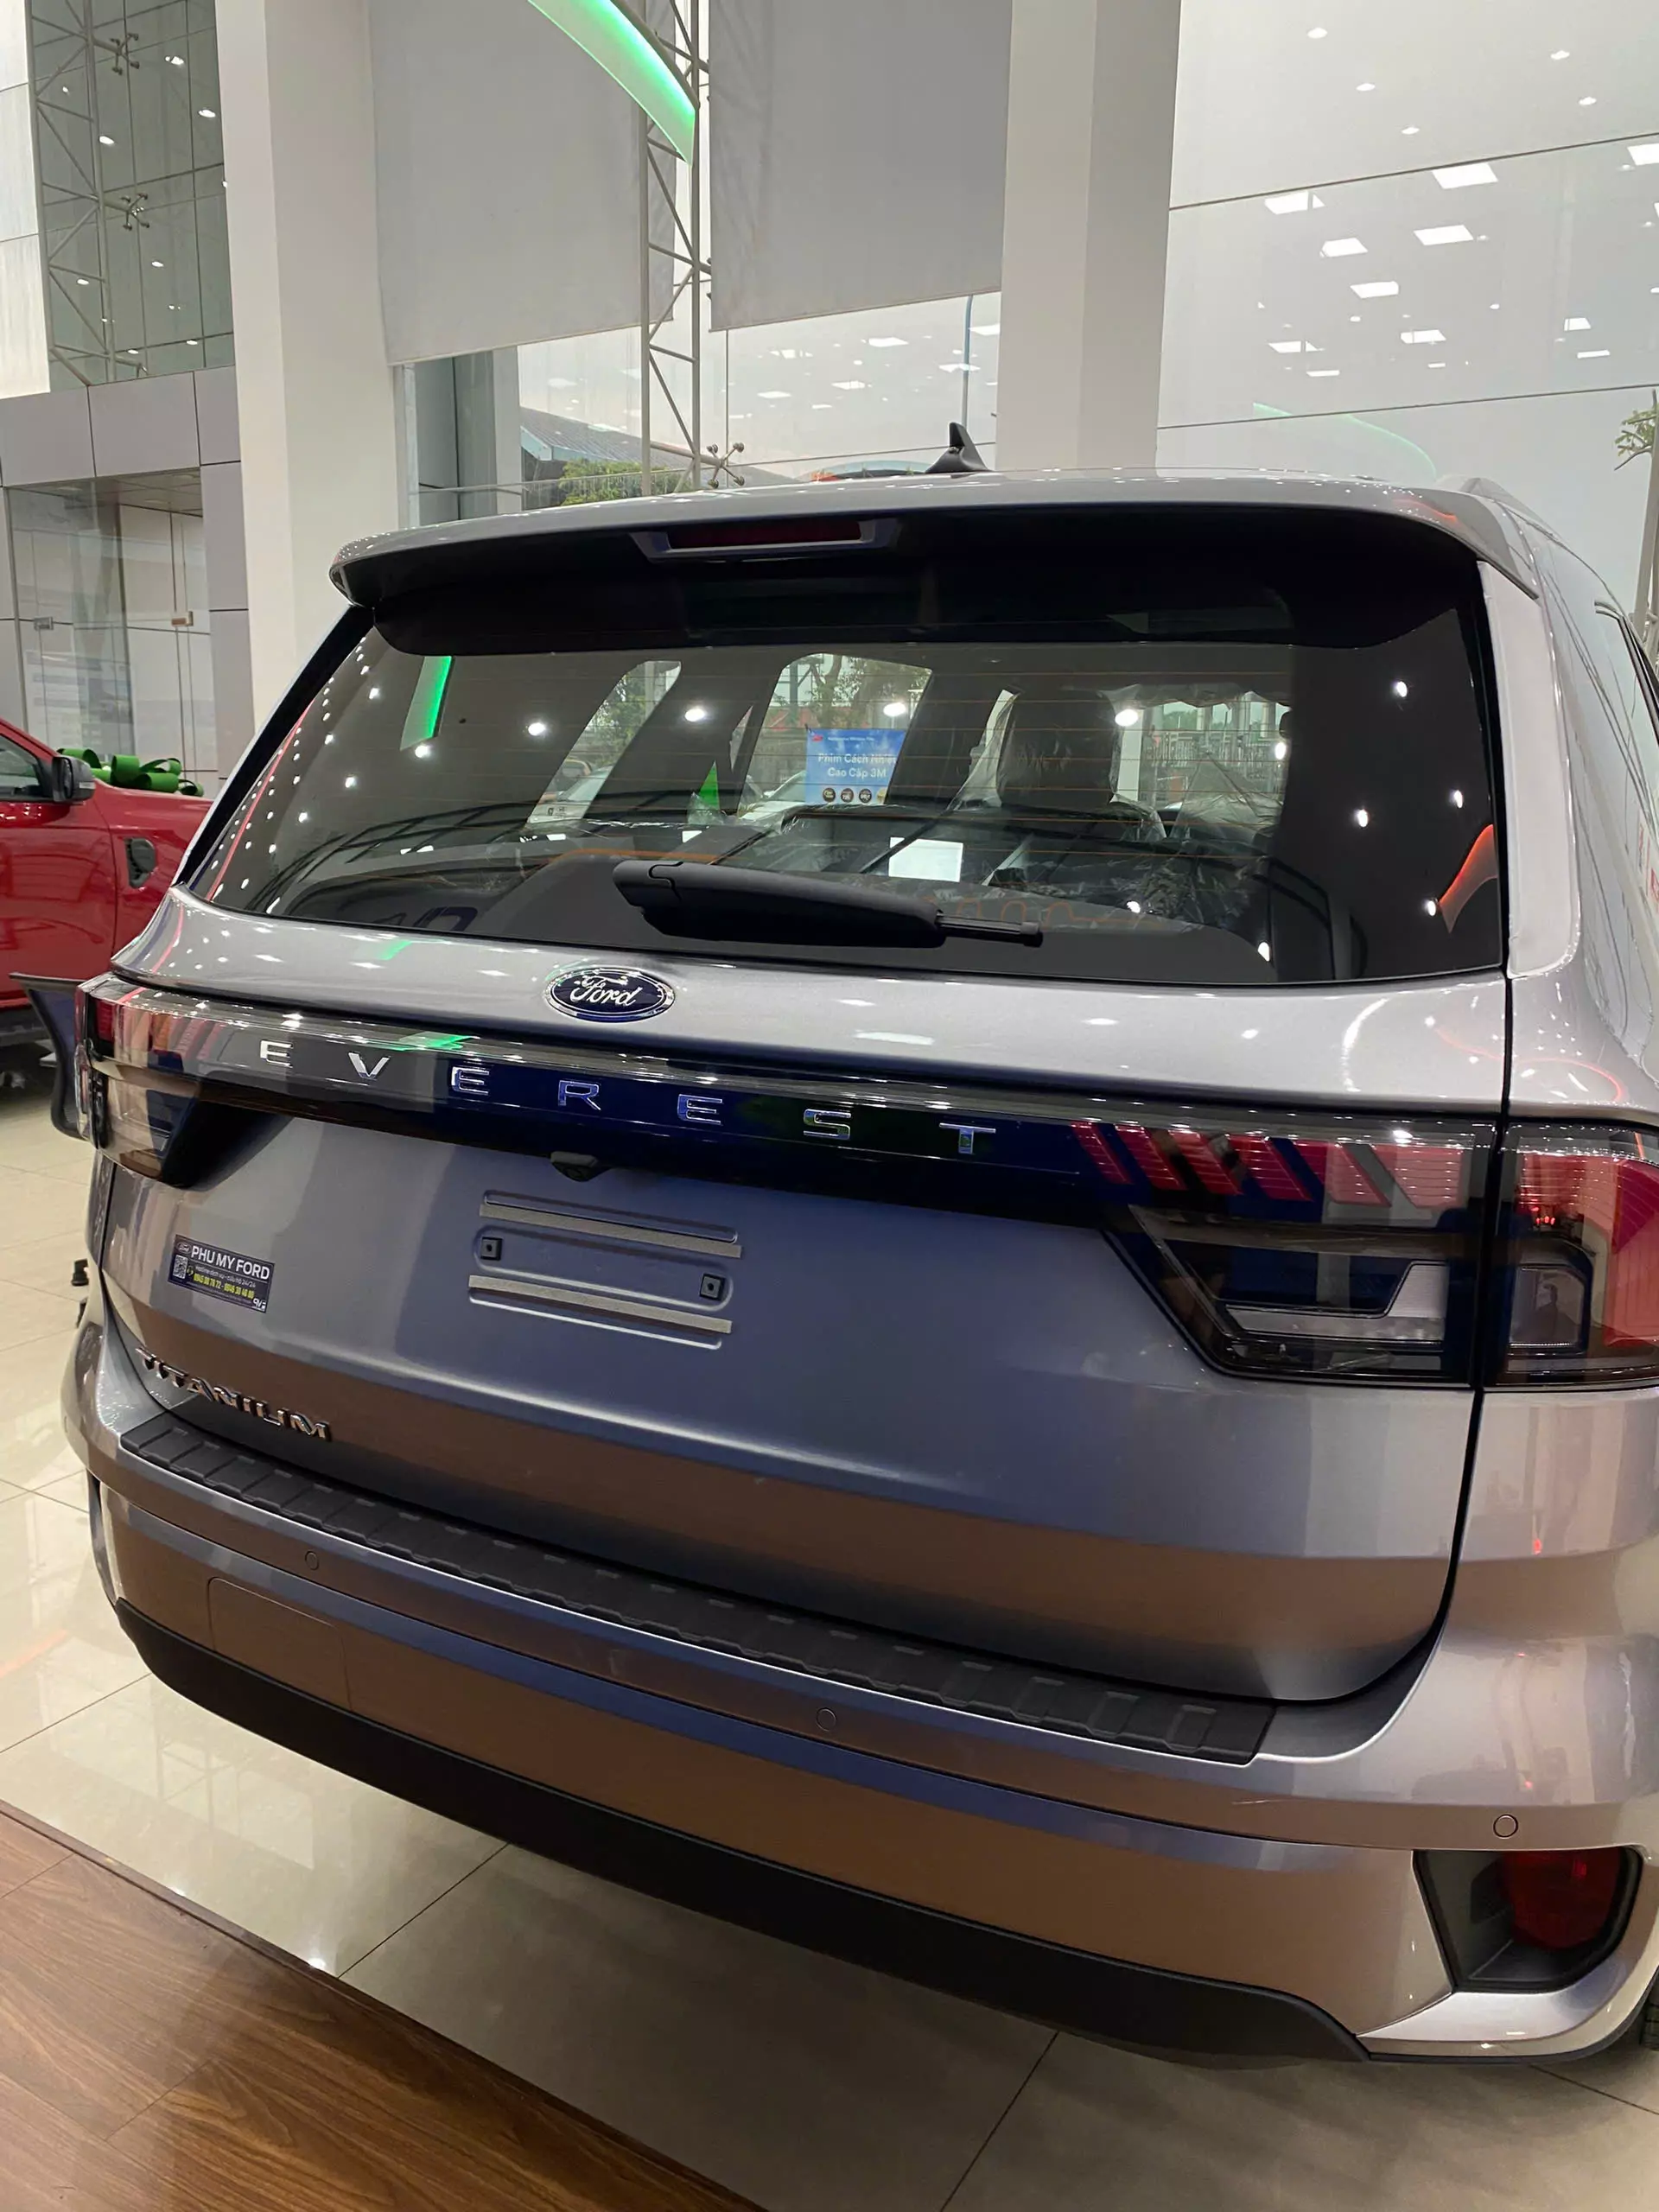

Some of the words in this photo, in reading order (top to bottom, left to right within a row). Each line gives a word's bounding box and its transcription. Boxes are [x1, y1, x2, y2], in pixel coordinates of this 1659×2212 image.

[828, 767, 847, 776] Cao
[871, 768, 886, 777] 3M
[569, 975, 643, 1006] Ford
[259, 1039, 996, 1154] EVEREST
[190, 1245, 215, 1263] PHU
[216, 1253, 235, 1269] MY
[236, 1260, 270, 1280] FORD
[136, 1347, 330, 1440] TITANIUM
